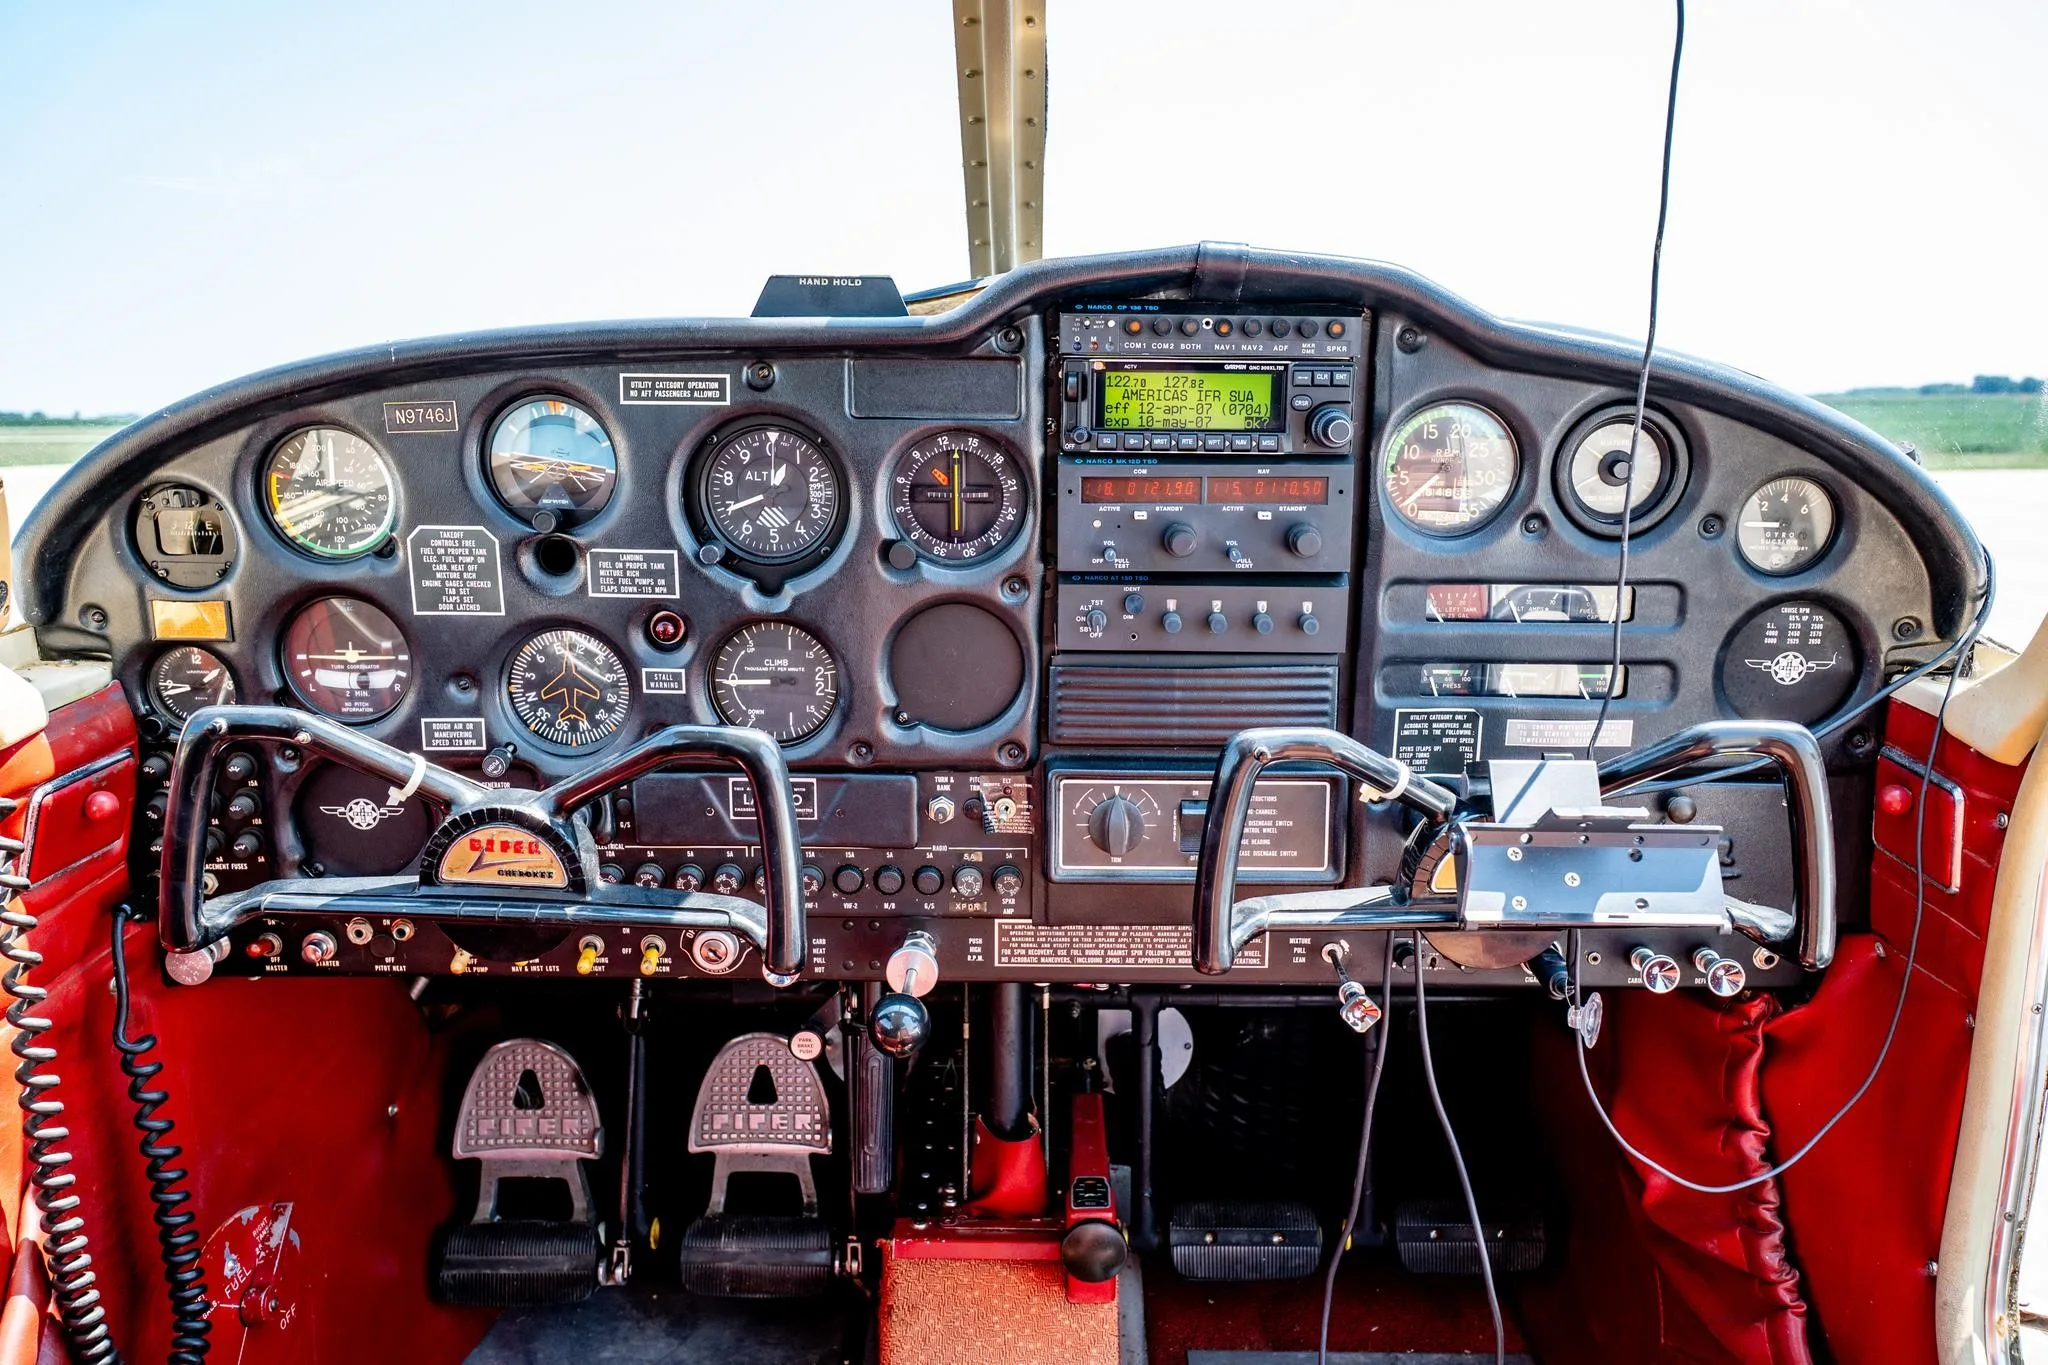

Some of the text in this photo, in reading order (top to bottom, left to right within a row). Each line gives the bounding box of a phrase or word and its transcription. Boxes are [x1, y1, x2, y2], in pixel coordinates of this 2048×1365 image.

[1106, 376, 1205, 388] 122.70 127.82
[1122, 390, 1254, 402] AMERICAS IFR SUA
[1106, 402, 1269, 416] eff 12-apr-07 (0704)
[395, 408, 453, 425] N9746J
[1106, 416, 1270, 429] exp 10-may-07 ok?
[1424, 424, 1438, 440] 15
[1451, 424, 1471, 439] 20
[937, 436, 949, 446] 12
[968, 437, 979, 448] 15
[1404, 445, 1420, 460] 10
[724, 471, 733, 486] 8
[745, 471, 768, 481] ALT
[1781, 493, 1789, 503] 4
[811, 504, 820, 518] 3
[1801, 504, 1808, 514] 6
[769, 528, 779, 543] 5
[498, 869, 554, 879] CHEROKEE
[477, 1118, 580, 1136] PIPER
[712, 1113, 812, 1131] PIPER
[224, 1266, 252, 1299] FUEL
[280, 1303, 296, 1330] OFF
